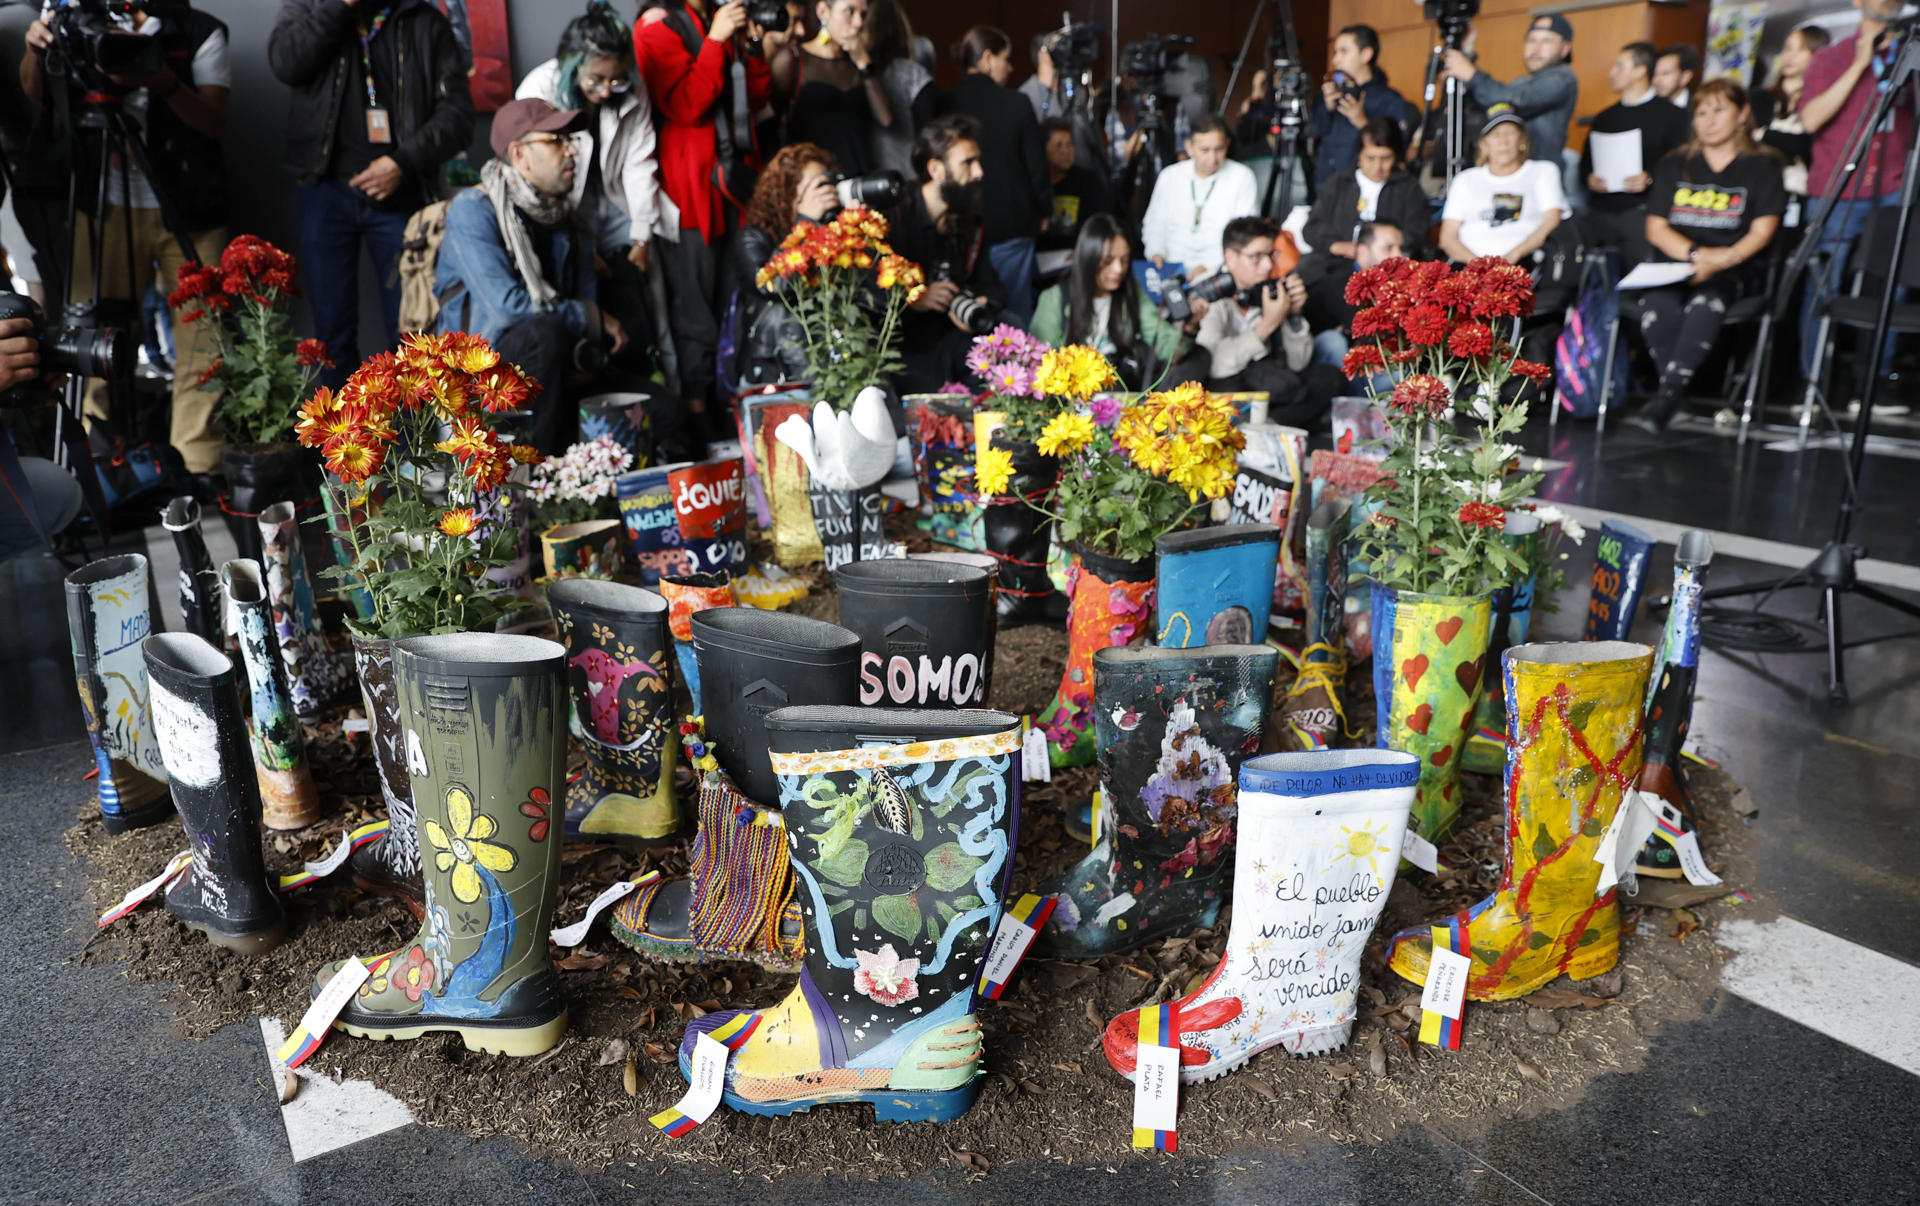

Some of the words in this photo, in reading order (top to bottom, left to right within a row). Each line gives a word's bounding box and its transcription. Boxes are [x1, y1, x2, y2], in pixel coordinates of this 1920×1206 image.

[676, 469, 746, 515] ¿QUIÉ
[1332, 774, 1348, 790] NO
[1352, 773, 1370, 784] HAY
[1276, 872, 1307, 901] El
[1314, 873, 1384, 919] pueblo
[1258, 914, 1329, 940] unido
[1241, 951, 1314, 982] será
[1143, 1064, 1153, 1093] PLATA
[1155, 1064, 1166, 1101] RAFAEL
